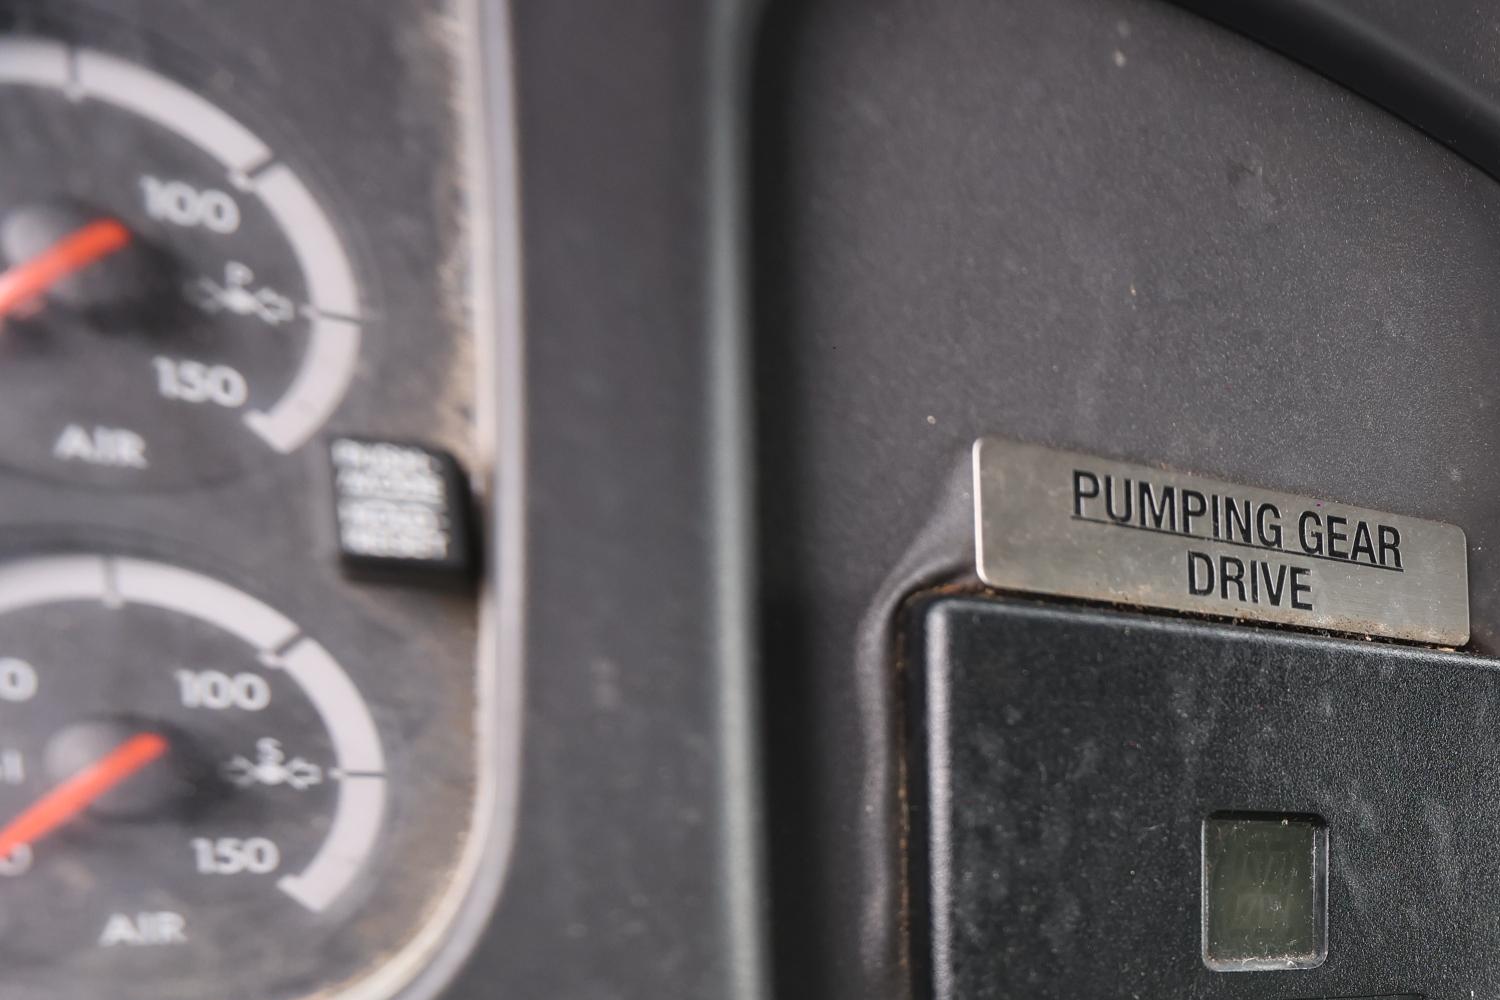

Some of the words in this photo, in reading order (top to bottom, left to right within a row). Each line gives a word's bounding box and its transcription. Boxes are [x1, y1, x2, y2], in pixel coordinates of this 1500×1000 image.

[142, 177, 240, 233] 100
[151, 356, 247, 407] 150
[53, 424, 147, 469] AIR
[1072, 468, 1284, 549] PUMPING
[1299, 510, 1403, 568] GEAR
[1188, 550, 1314, 611] DRIVE
[174, 669, 270, 710] 100
[190, 837, 280, 874] 150
[99, 911, 187, 946] AIR
